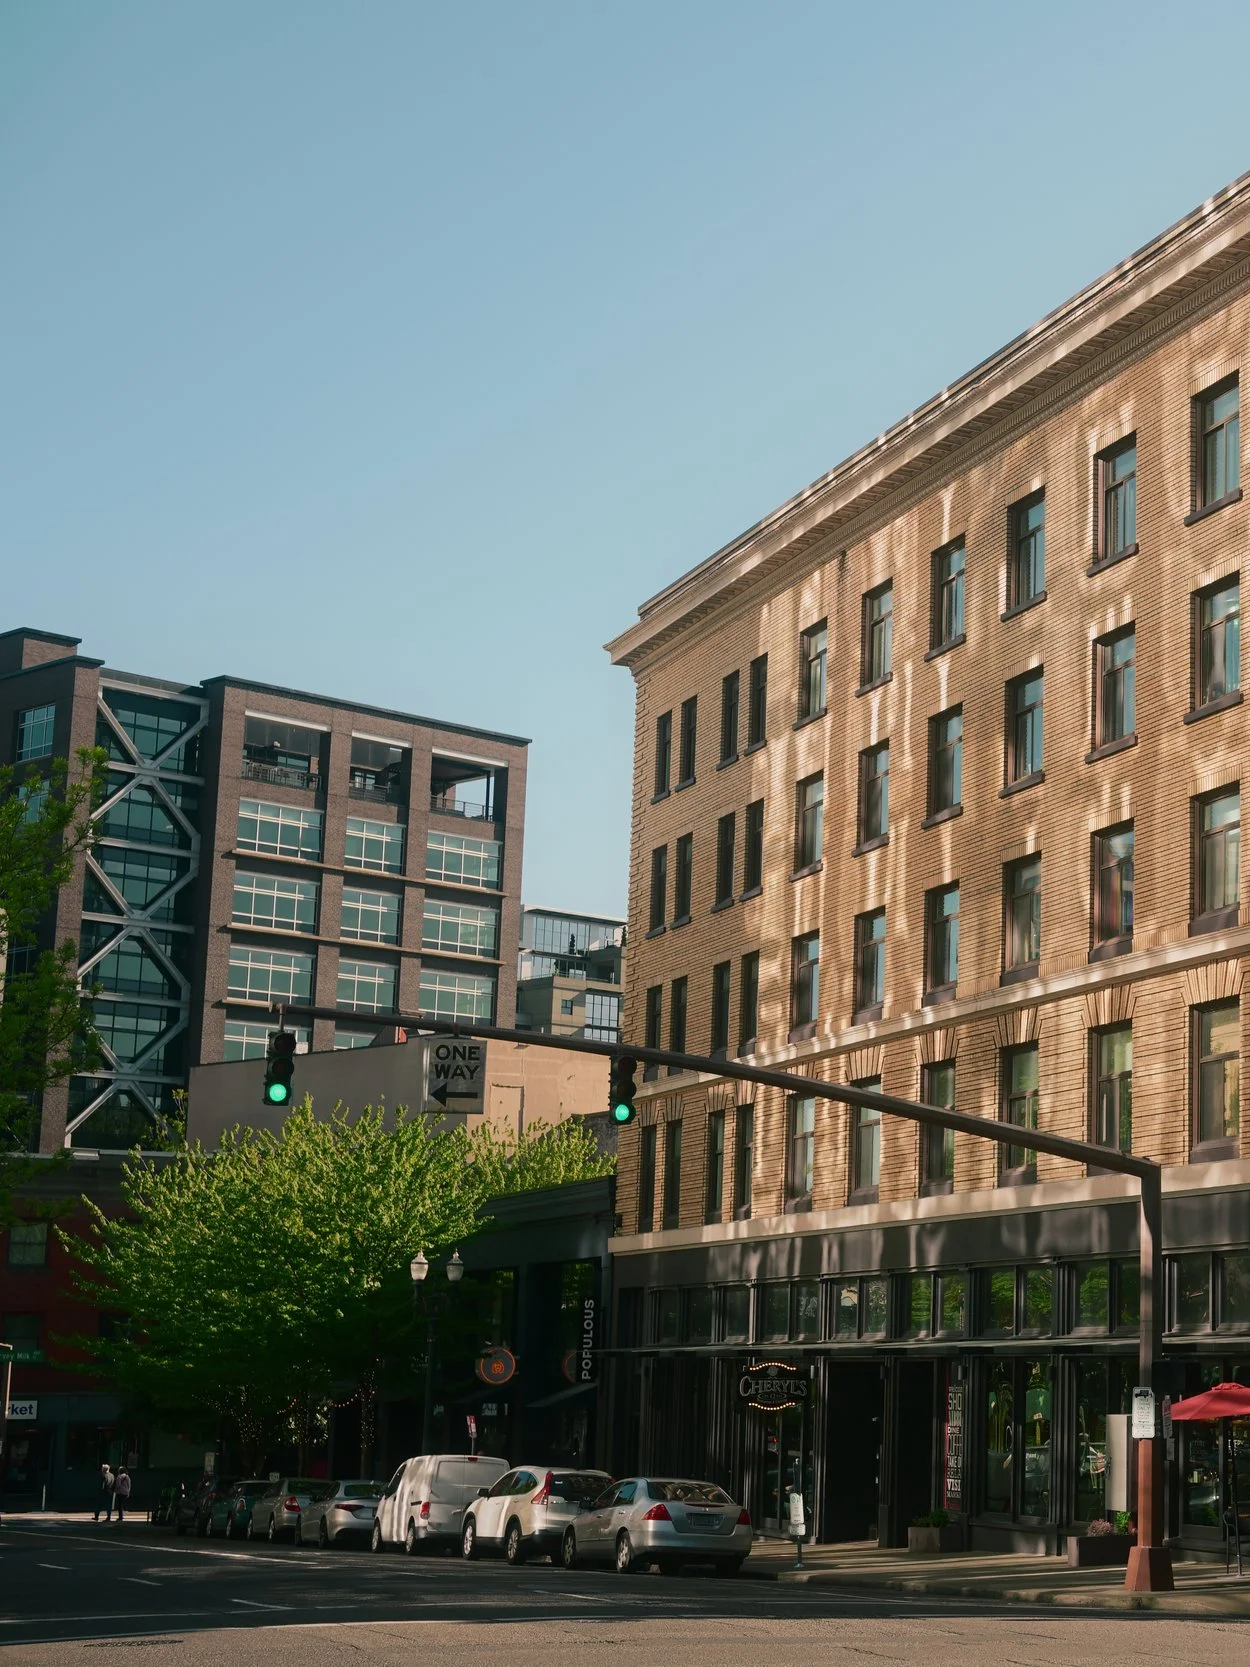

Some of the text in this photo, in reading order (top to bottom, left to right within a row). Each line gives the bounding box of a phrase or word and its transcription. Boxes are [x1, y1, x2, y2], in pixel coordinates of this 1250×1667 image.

[435, 1044, 481, 1061] ONE
[434, 1063, 480, 1080] WAY
[581, 1299, 595, 1380] POPULOUS
[739, 1376, 808, 1397] CHERYL'S
[8, 1404, 34, 1415] ket
